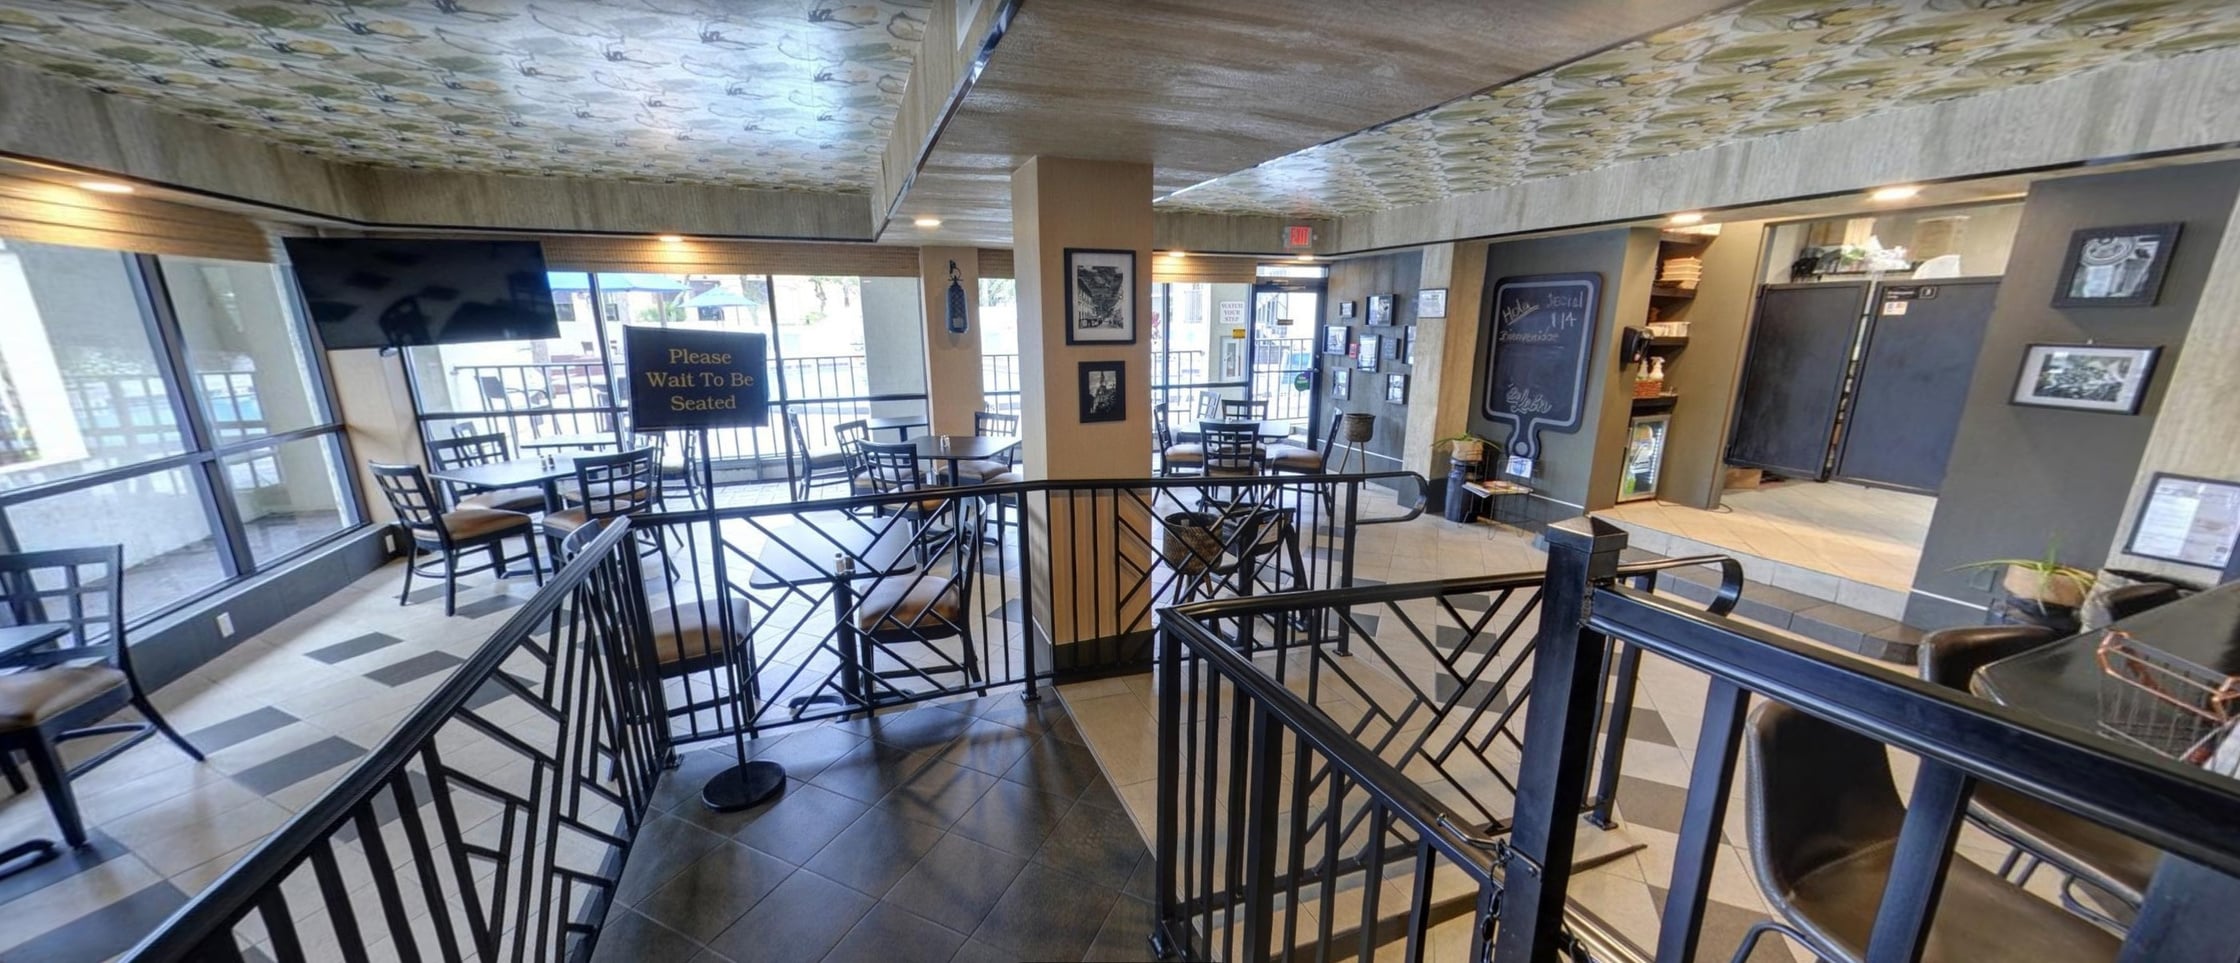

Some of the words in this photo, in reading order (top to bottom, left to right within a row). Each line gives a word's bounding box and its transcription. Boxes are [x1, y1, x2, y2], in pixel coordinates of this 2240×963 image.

[1290, 227, 1309, 245] EXIT
[669, 348, 732, 365] Please
[645, 371, 695, 388] Wait
[699, 372, 724, 388] To
[731, 372, 754, 387] Be
[670, 395, 737, 411] Seated
